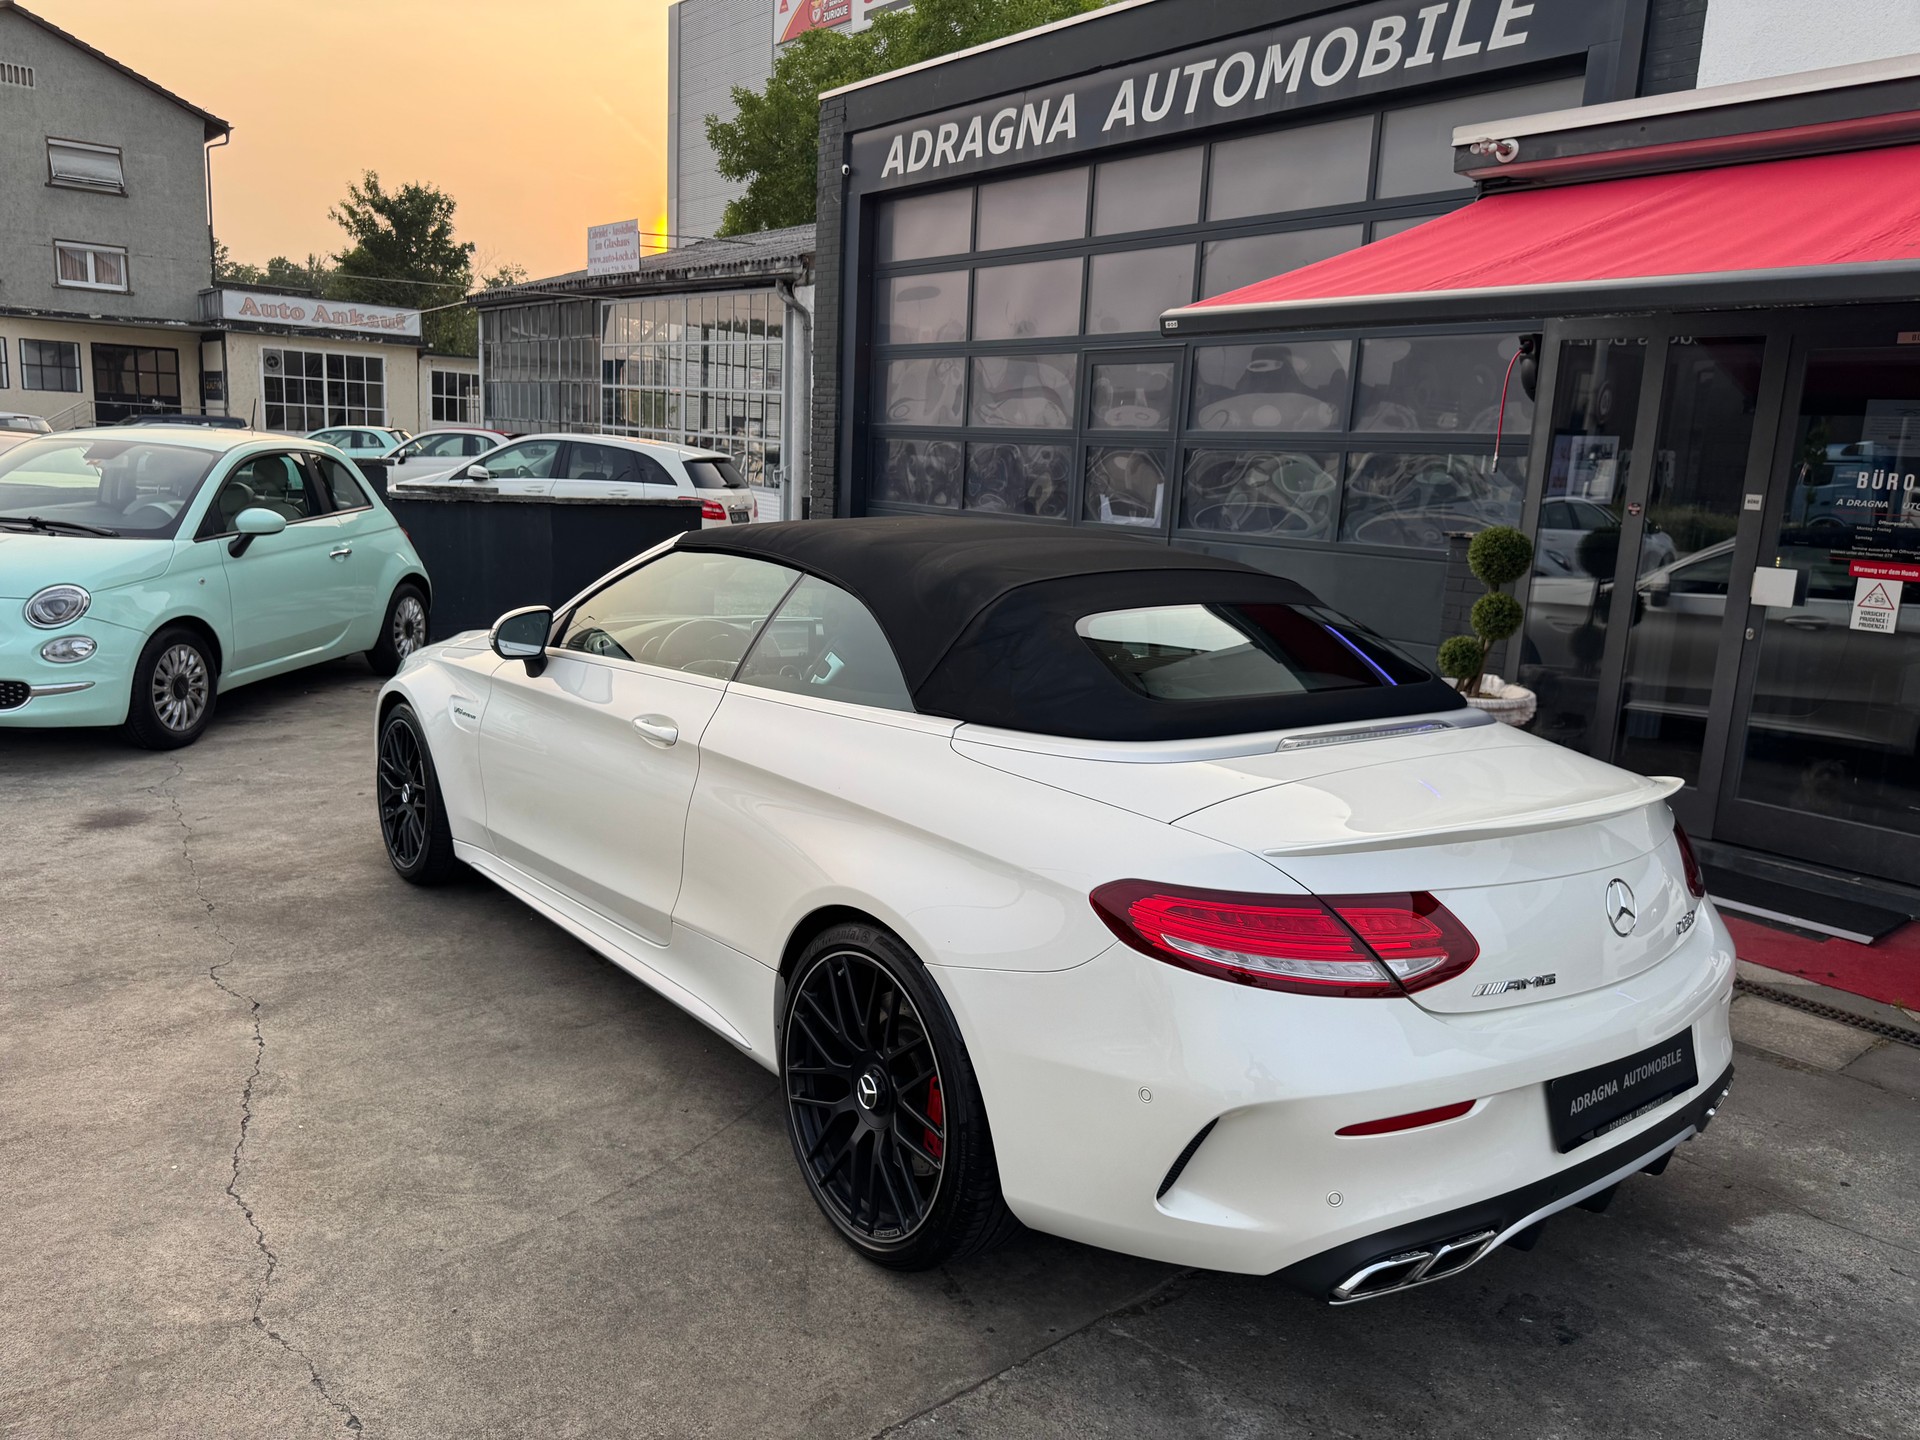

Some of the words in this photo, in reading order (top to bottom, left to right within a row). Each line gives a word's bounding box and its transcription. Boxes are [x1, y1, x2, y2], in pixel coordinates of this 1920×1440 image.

[823, 4, 848, 22] ZURIQUE
[880, 92, 1078, 179] ADRAGNA
[1101, 0, 1536, 133] AUTOMOBILE
[595, 240, 603, 251] im
[603, 236, 630, 249] Glashaus
[238, 296, 306, 321] Auto
[311, 304, 406, 331] Ankauf
[1856, 469, 1915, 491] BÜRO
[1853, 565, 1878, 575] Warnung
[1878, 567, 1887, 575] vor
[1888, 567, 1901, 576] dem
[1901, 568, 1919, 578] Hunde
[1569, 1079, 1618, 1117] ADRAGNA
[1622, 1048, 1682, 1089] AUTOMOBILE
[1608, 1113, 1633, 1130] ADRAGNA
